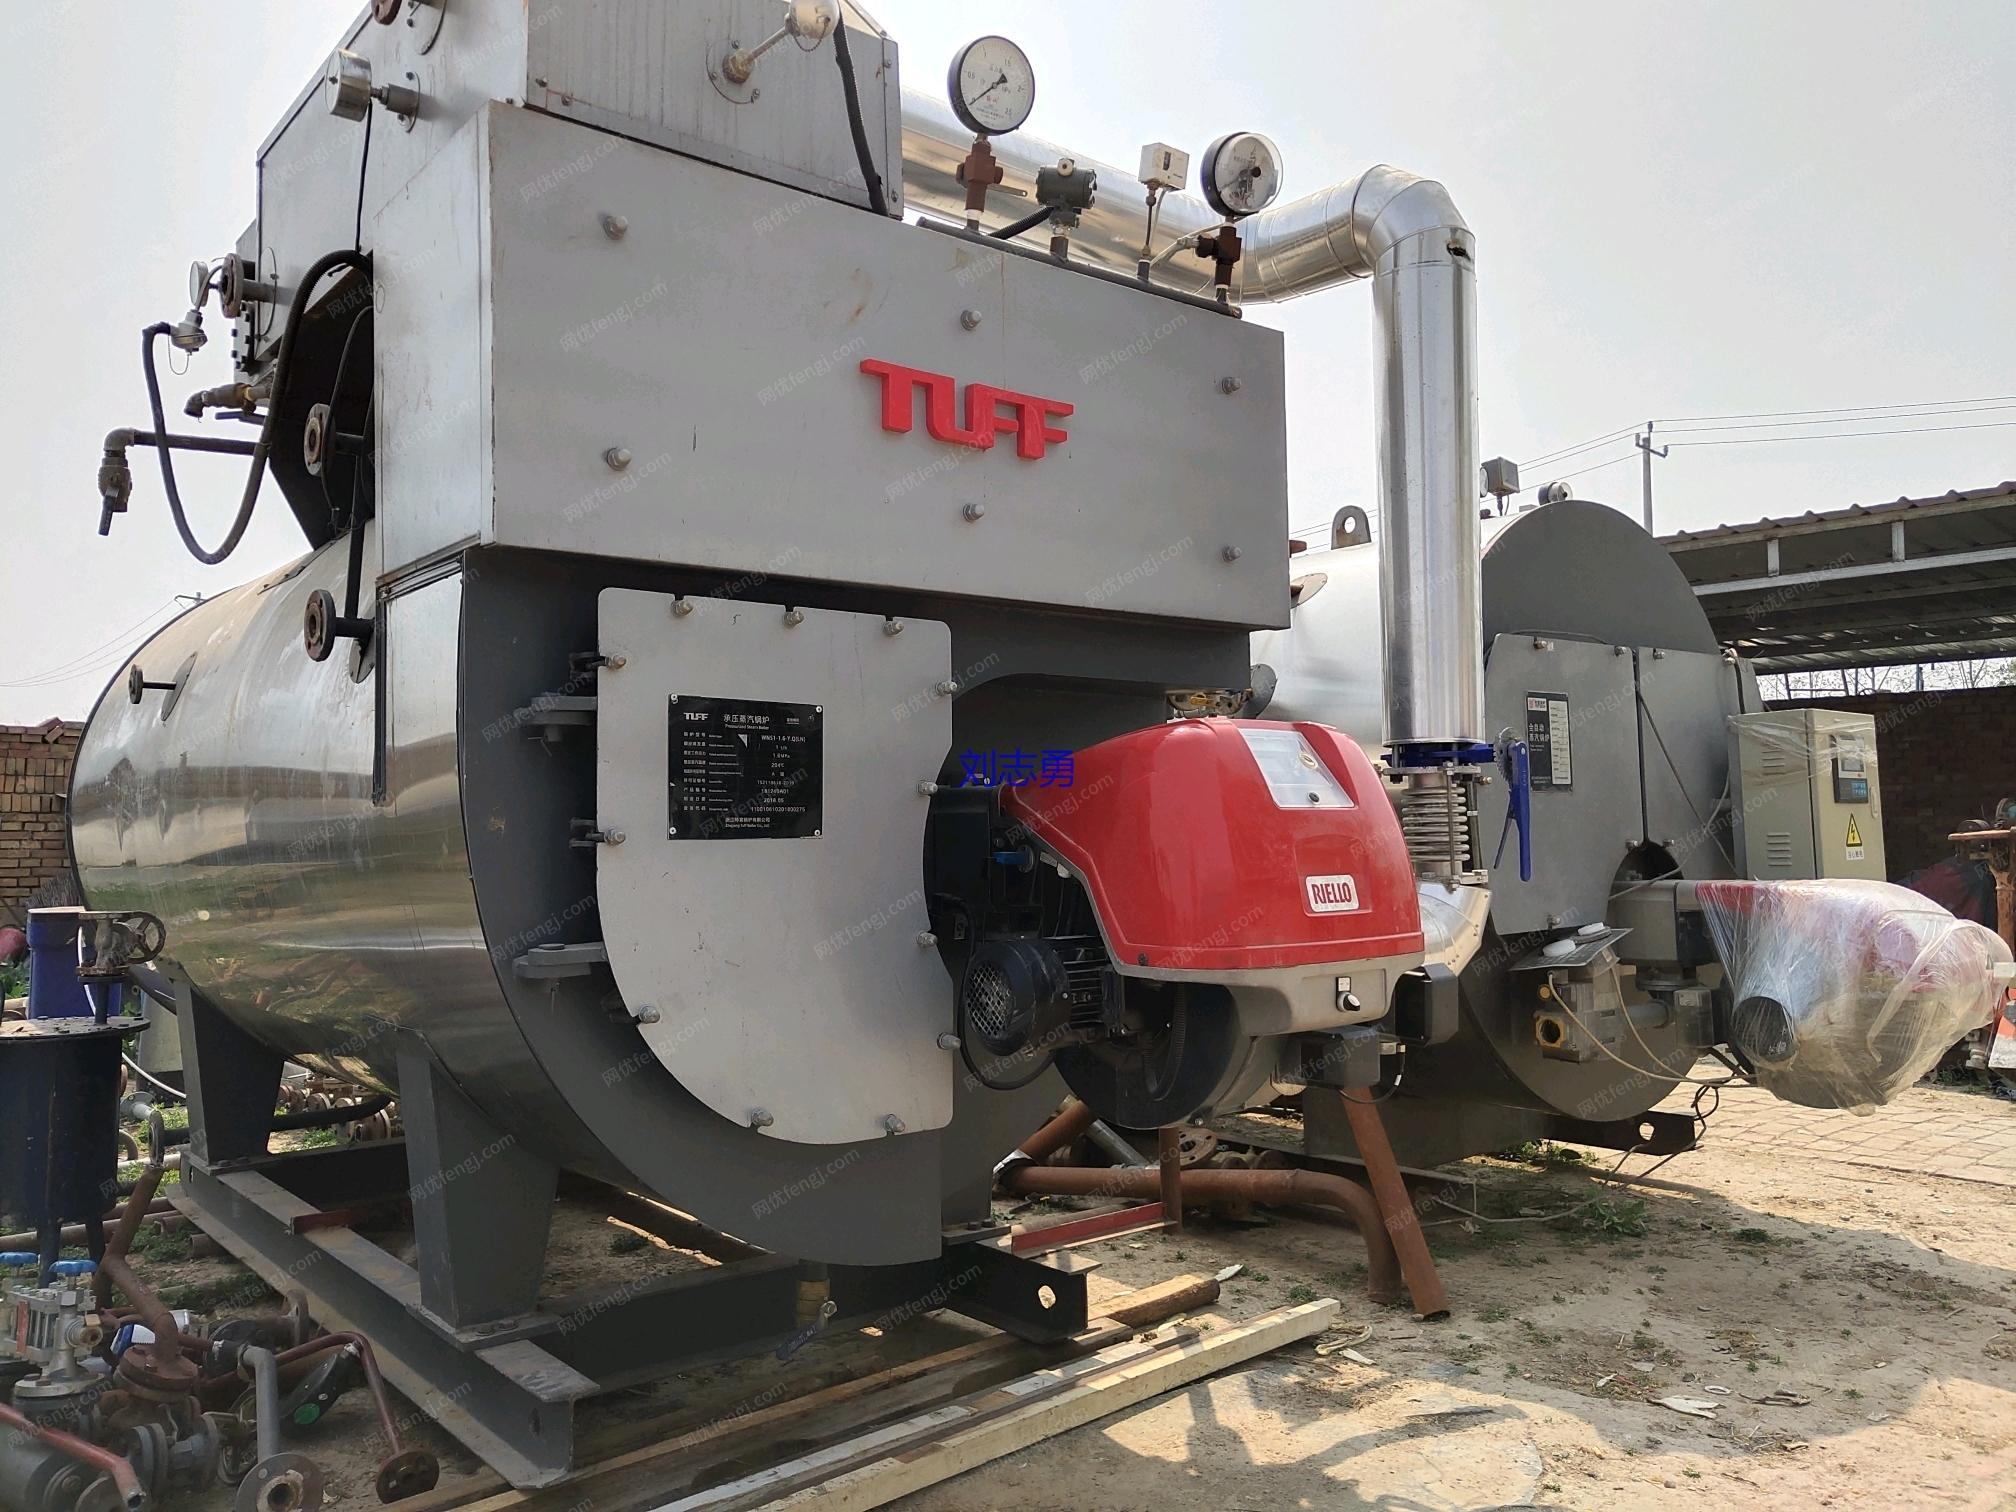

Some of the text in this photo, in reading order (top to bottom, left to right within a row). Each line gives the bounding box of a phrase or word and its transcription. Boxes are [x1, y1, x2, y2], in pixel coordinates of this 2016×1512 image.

[860, 358, 1075, 460] TUFF
[723, 714, 770, 723] 承压蒸汽锅炉
[1311, 882, 1352, 905] RIELLO
